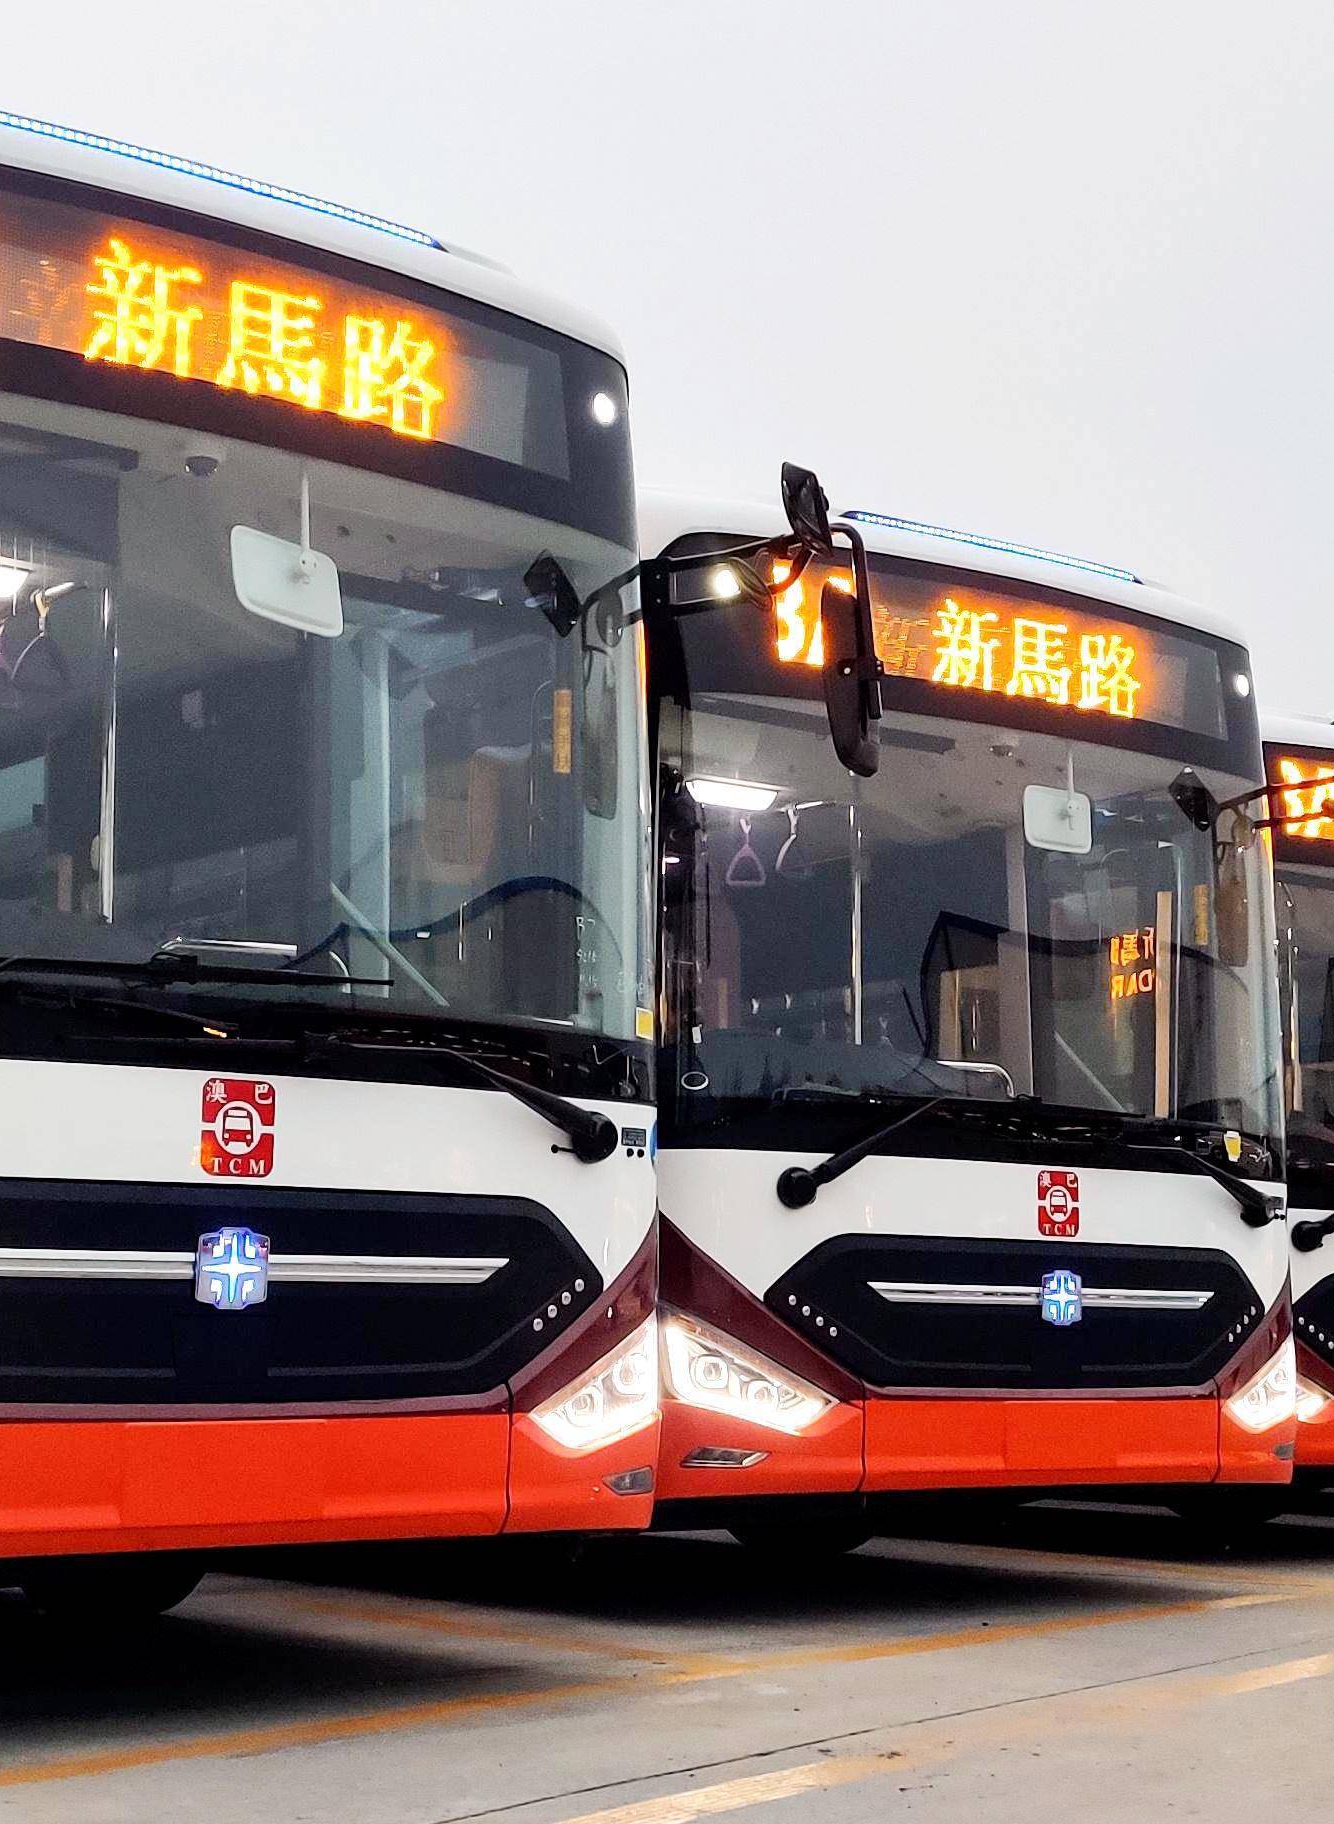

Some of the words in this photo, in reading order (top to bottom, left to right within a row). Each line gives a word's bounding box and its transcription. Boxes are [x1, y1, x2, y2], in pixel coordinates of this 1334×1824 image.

[83, 240, 445, 441] 新馬路
[932, 598, 1142, 719] 新馬路
[211, 1157, 265, 1175] TCM
